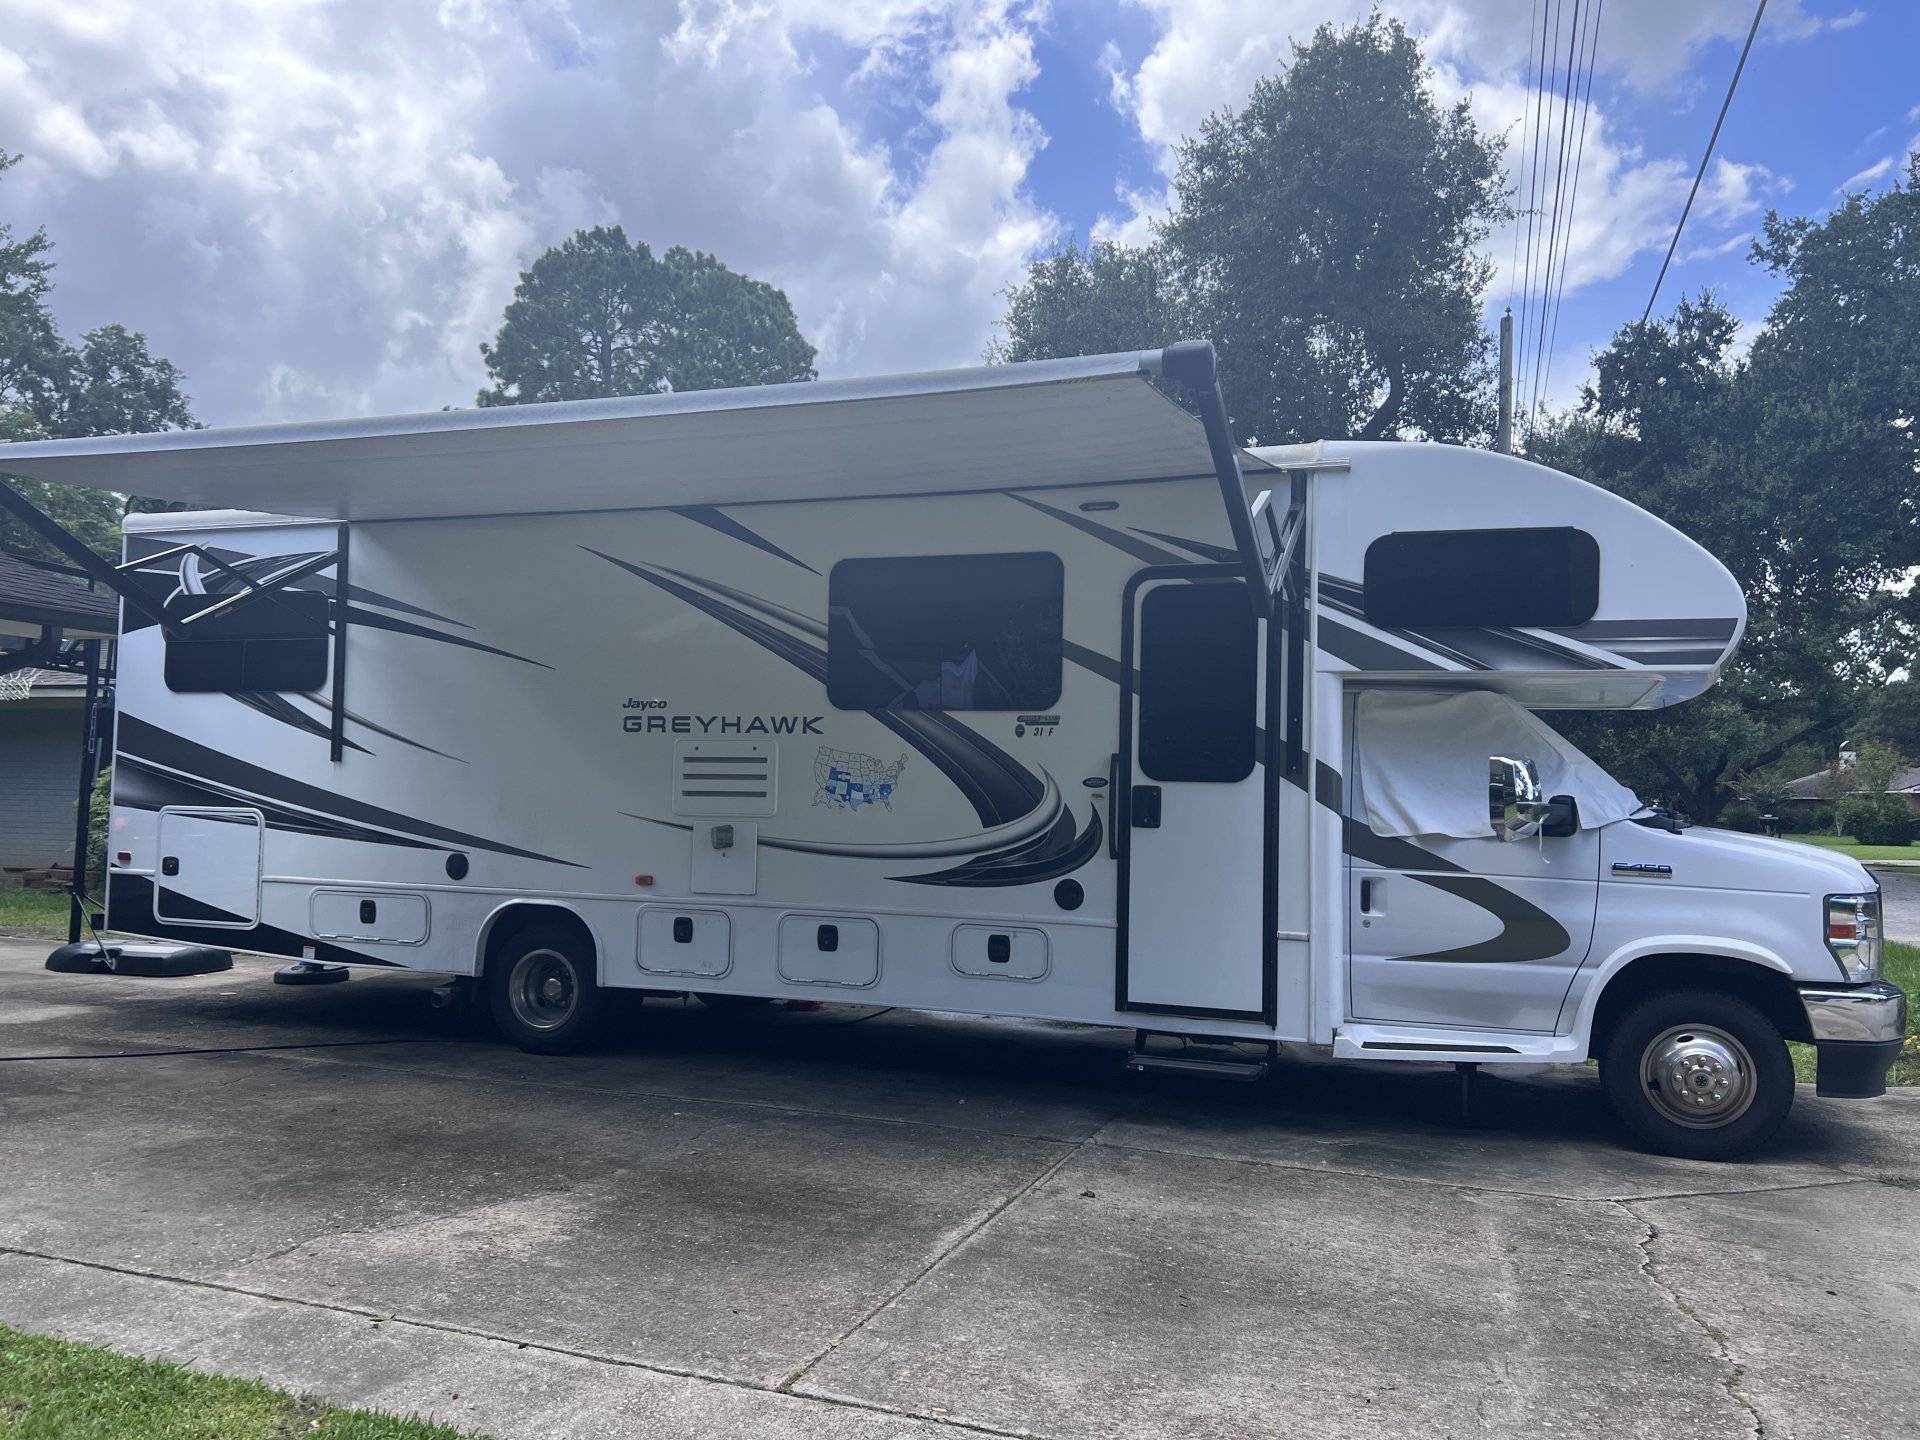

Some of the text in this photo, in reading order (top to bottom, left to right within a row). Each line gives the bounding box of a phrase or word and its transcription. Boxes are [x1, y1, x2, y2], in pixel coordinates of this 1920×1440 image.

[622, 698, 667, 711] Jayco
[623, 715, 825, 735] GREYHAWK
[1033, 727, 1043, 737] 31
